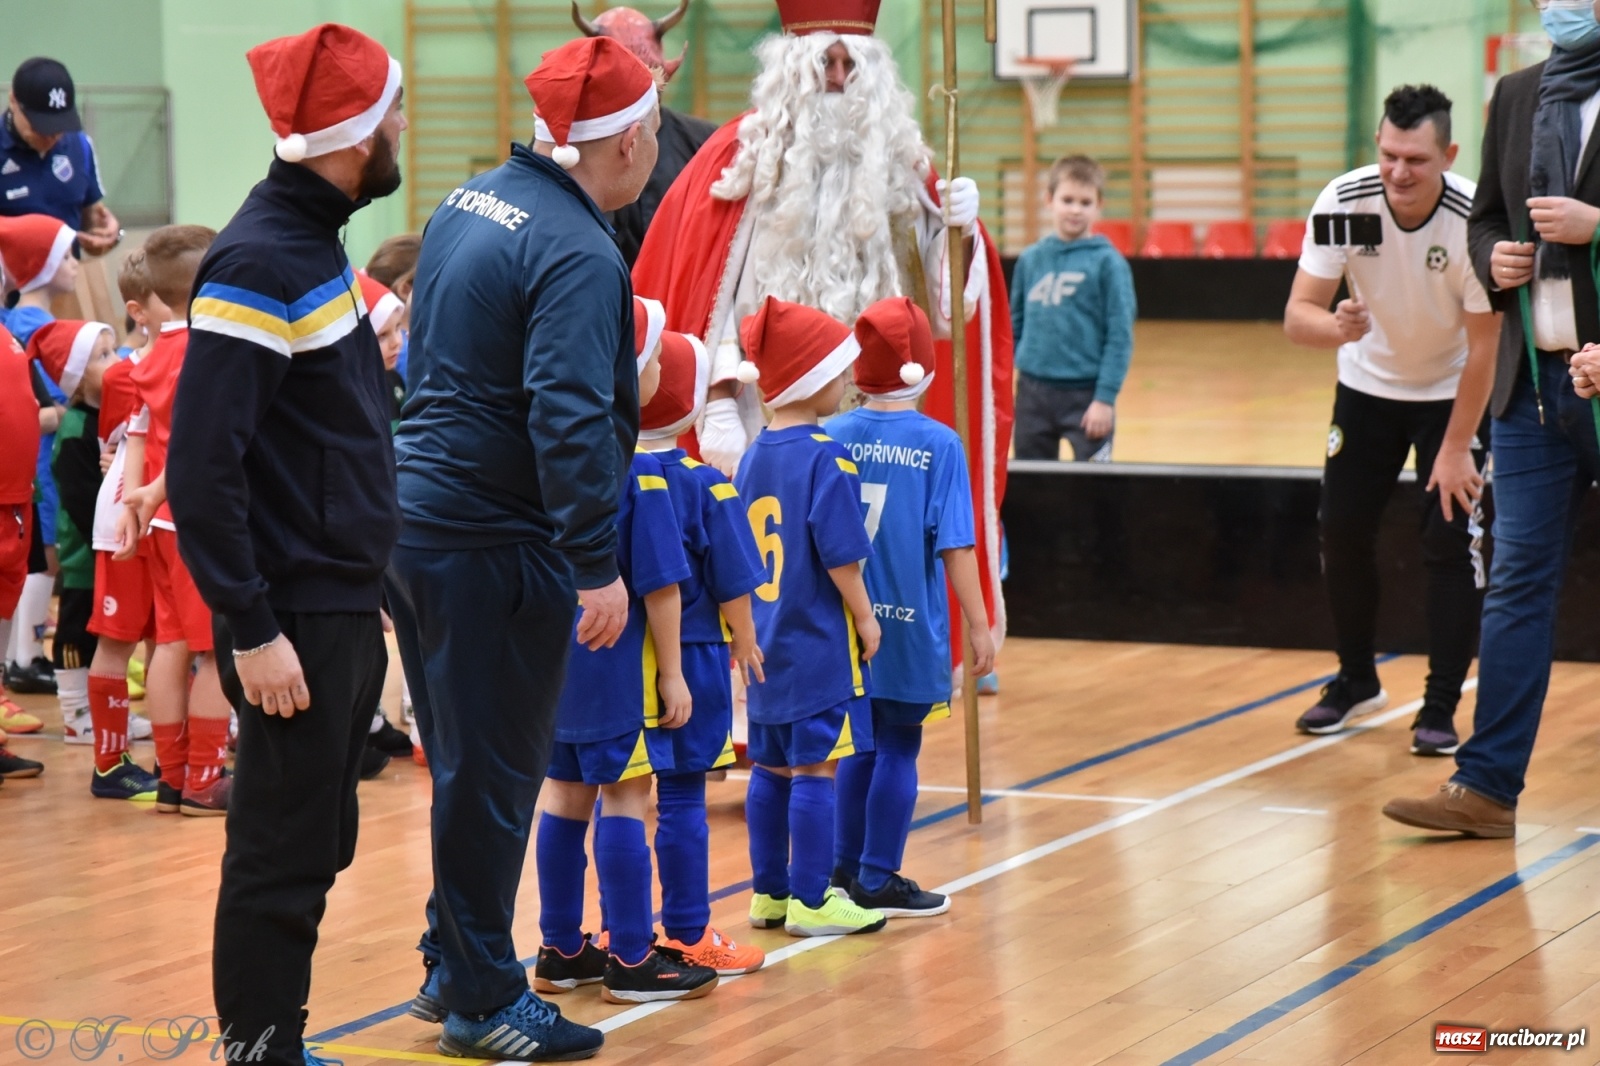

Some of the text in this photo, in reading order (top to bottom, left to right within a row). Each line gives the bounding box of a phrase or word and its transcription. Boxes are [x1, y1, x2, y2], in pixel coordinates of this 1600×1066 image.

[48, 87, 67, 109] NY
[1027, 271, 1087, 307] 4F
[746, 495, 784, 602] 6
